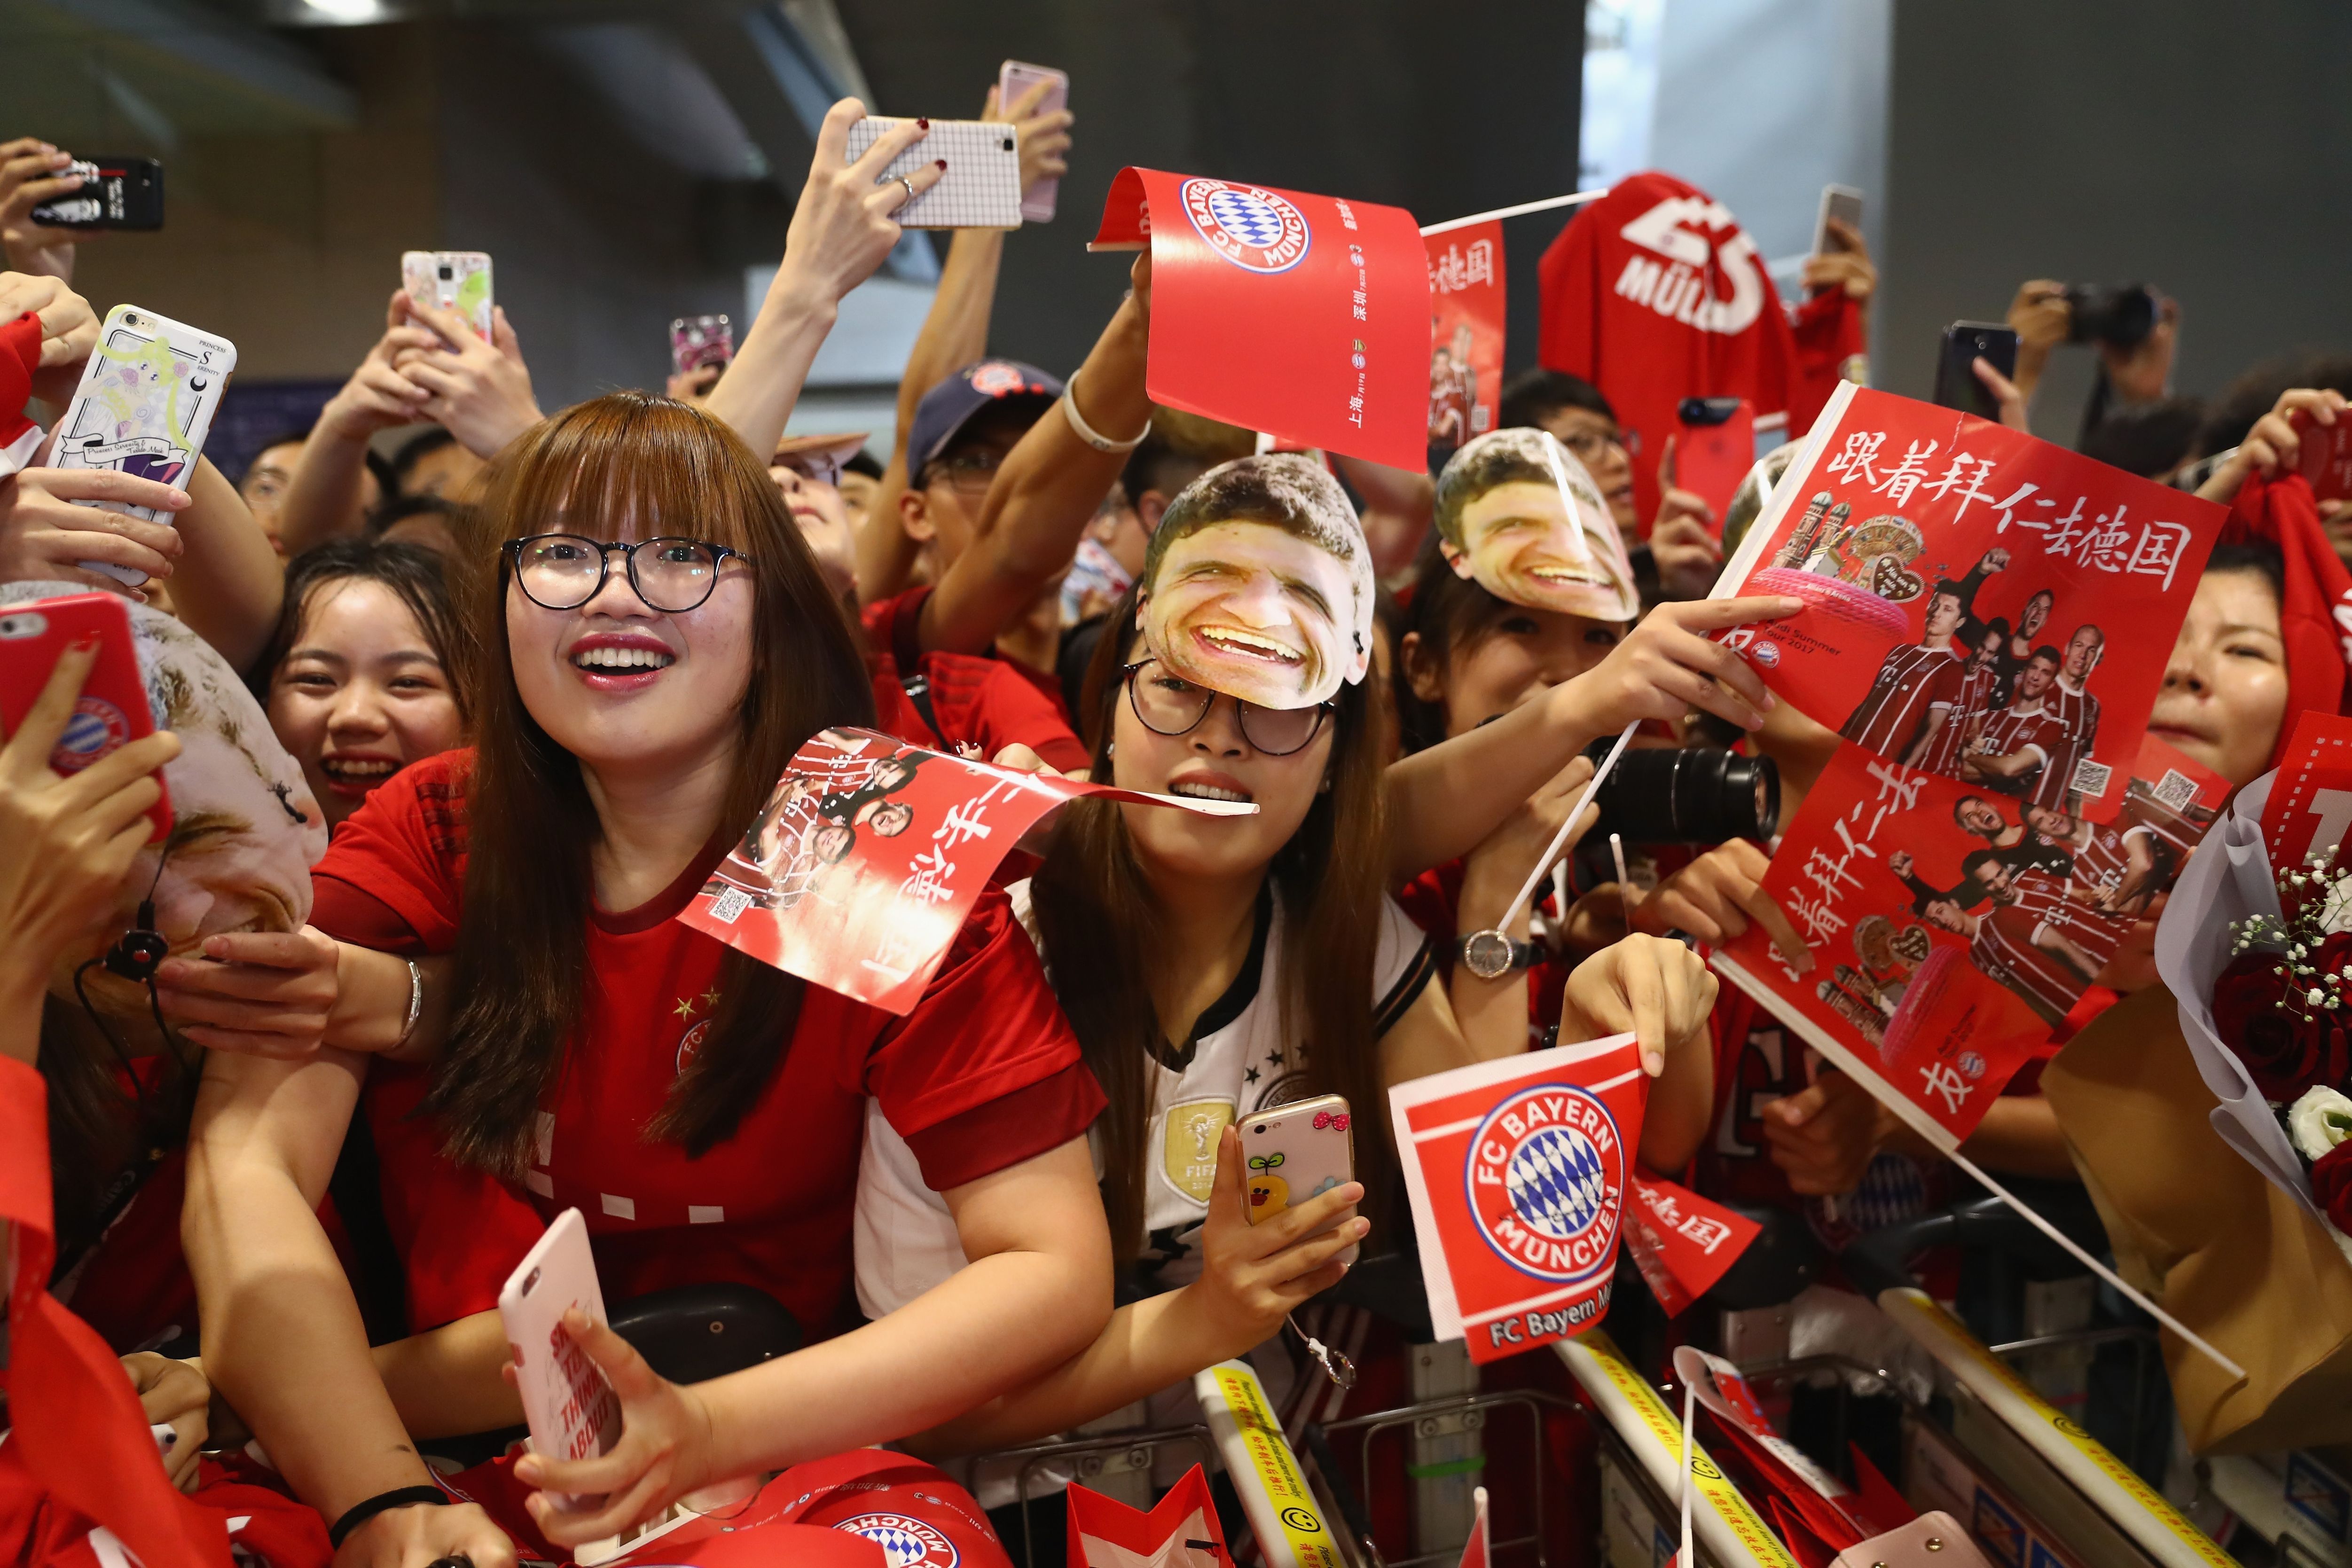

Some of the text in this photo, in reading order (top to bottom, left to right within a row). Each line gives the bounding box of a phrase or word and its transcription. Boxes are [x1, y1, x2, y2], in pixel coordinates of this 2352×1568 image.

[1189, 180, 1242, 258] FC BAYERN
[1353, 290, 1367, 321] 深圳
[199, 339, 227, 353] PRINCESS
[199, 351, 212, 365] S
[197, 365, 220, 376] ERENITY
[1348, 395, 1364, 429] 上海
[114, 440, 140, 451] Serenity
[1827, 431, 2192, 592] 跟着拜仁去德国
[1764, 626, 1815, 654] Tour 2017
[1793, 629, 1842, 656] Summer
[683, 1032, 702, 1054] FC
[1918, 1062, 1974, 1114] 友
[1478, 1097, 1614, 1185] FC BAYERN
[1494, 1185, 1619, 1269] MÜNCHEN
[1490, 1280, 1614, 1348] FC Bayern M
[841, 1516, 949, 1553] MÜNCHE
